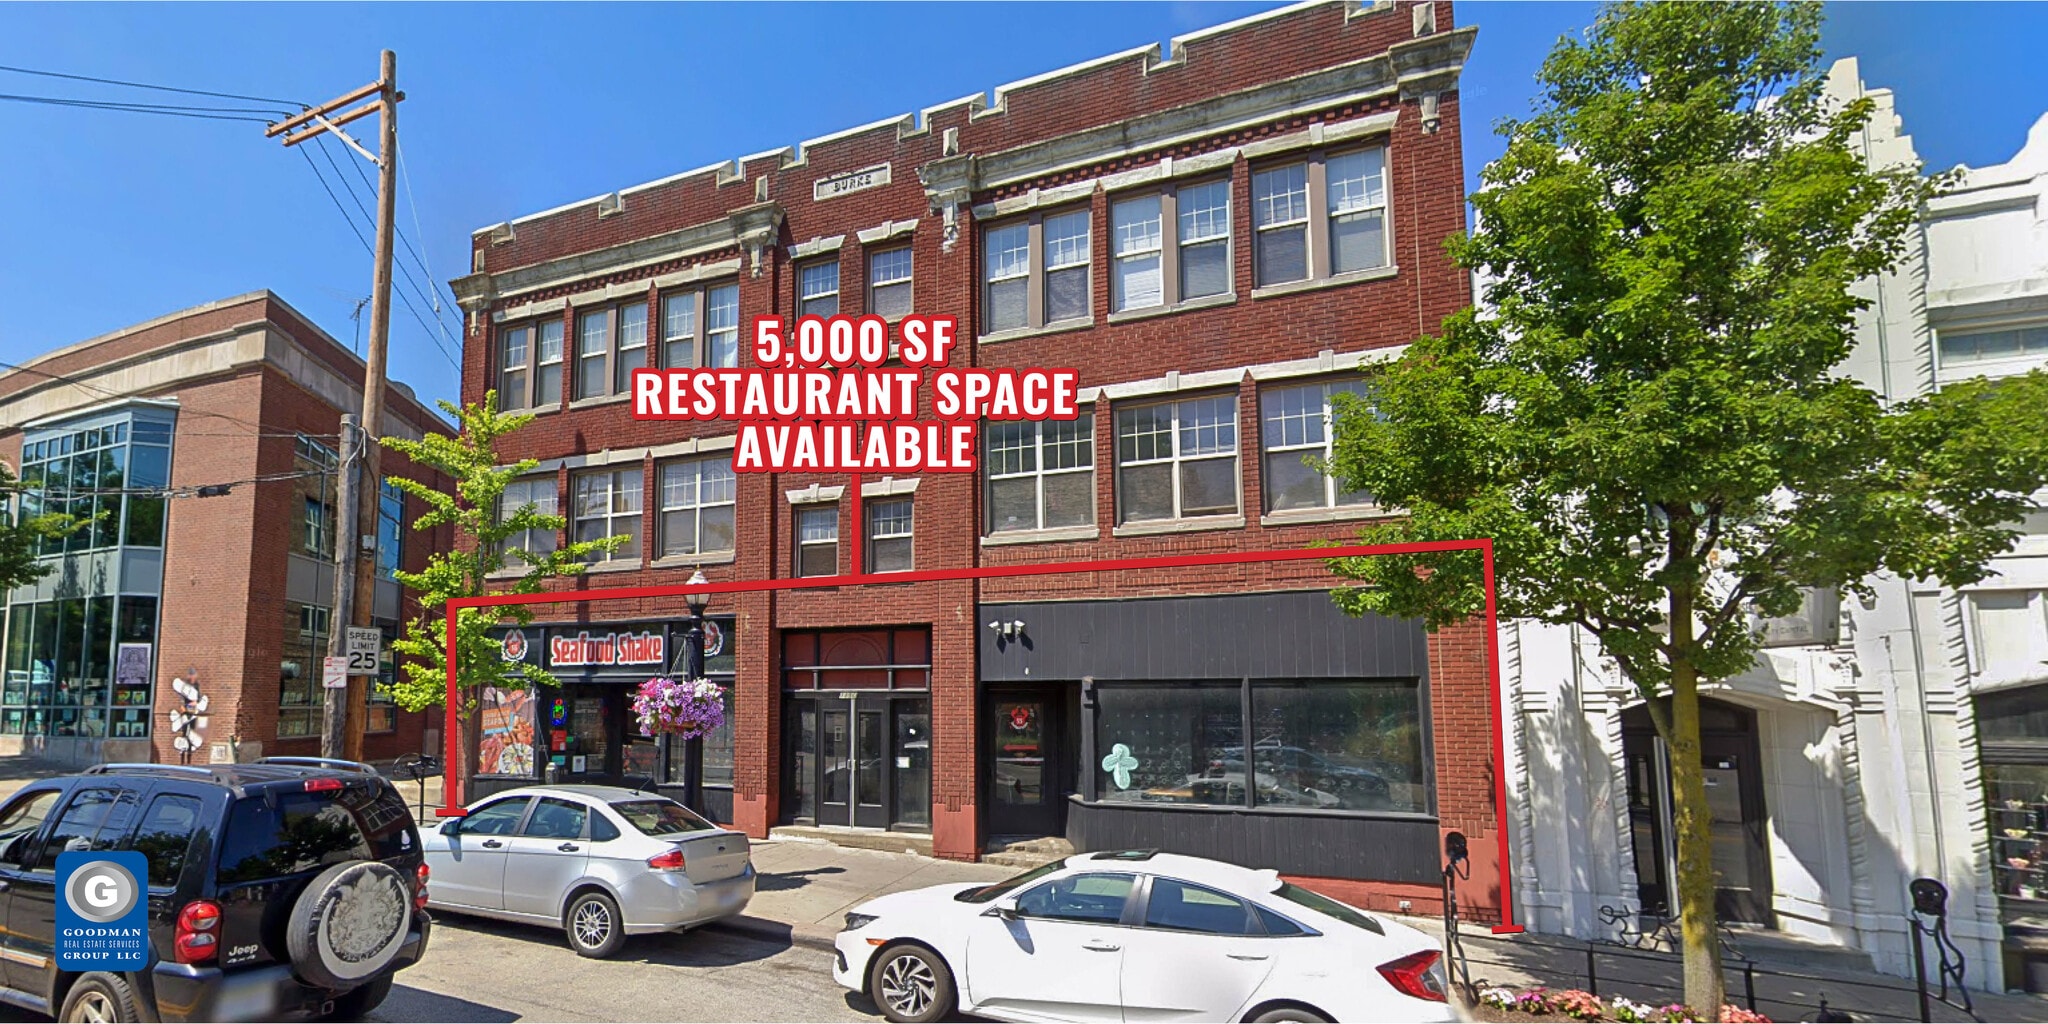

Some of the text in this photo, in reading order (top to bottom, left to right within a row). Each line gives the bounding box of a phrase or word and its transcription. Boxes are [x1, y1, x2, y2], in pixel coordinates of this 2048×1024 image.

[834, 174, 871, 192] BURKE
[348, 631, 379, 641] SPEED
[351, 642, 375, 650] LIMIT
[552, 632, 663, 664] Seafood Shake
[349, 651, 376, 669] 25
[228, 944, 259, 956] Jeep
